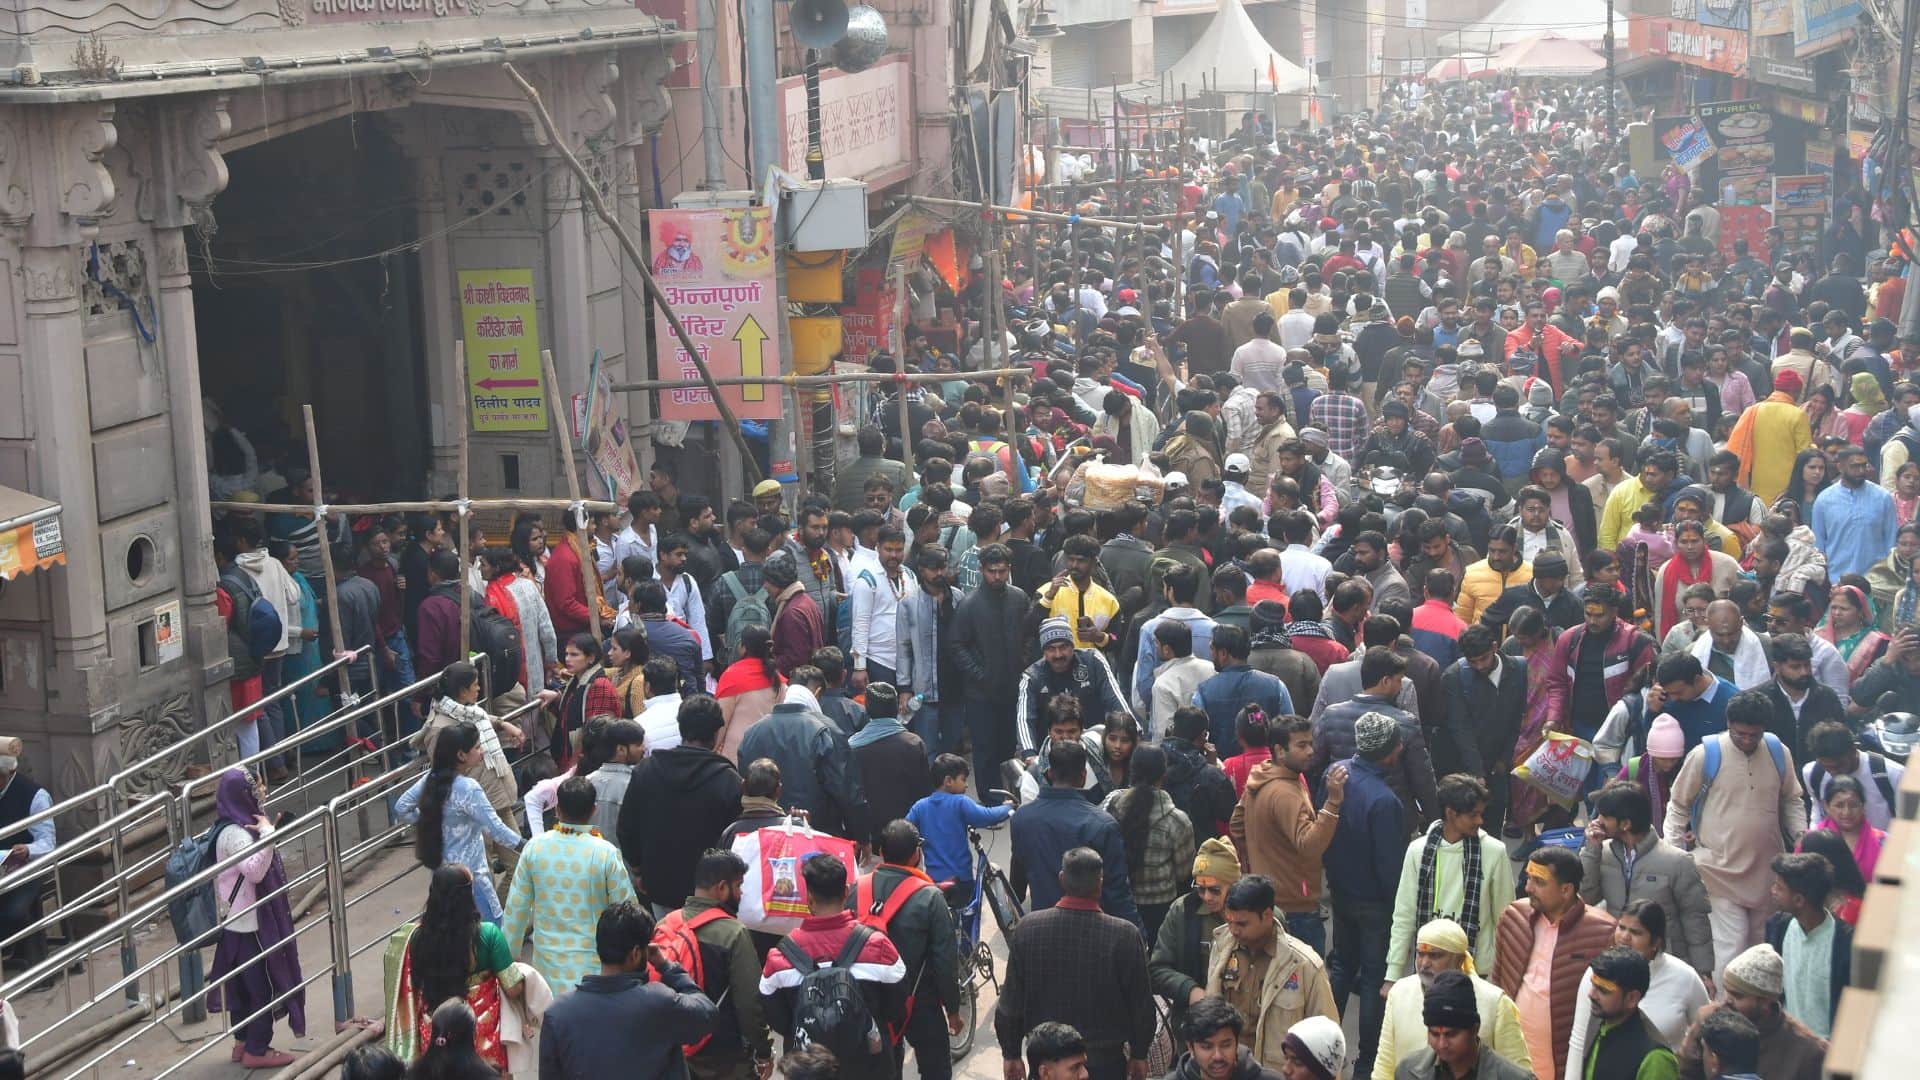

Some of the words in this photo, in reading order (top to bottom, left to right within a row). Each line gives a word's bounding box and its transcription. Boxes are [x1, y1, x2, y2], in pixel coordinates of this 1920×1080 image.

[1716, 104, 1746, 114] PURE
[464, 281, 474, 304] श्री
[475, 282, 495, 304] काशी
[665, 282, 762, 310] अन्नपूर्णा
[507, 315, 524, 337] जाने
[488, 354, 499, 370] का
[501, 348, 519, 370] मार्ग
[474, 395, 508, 409] दिलीप
[512, 397, 541, 409] यादव
